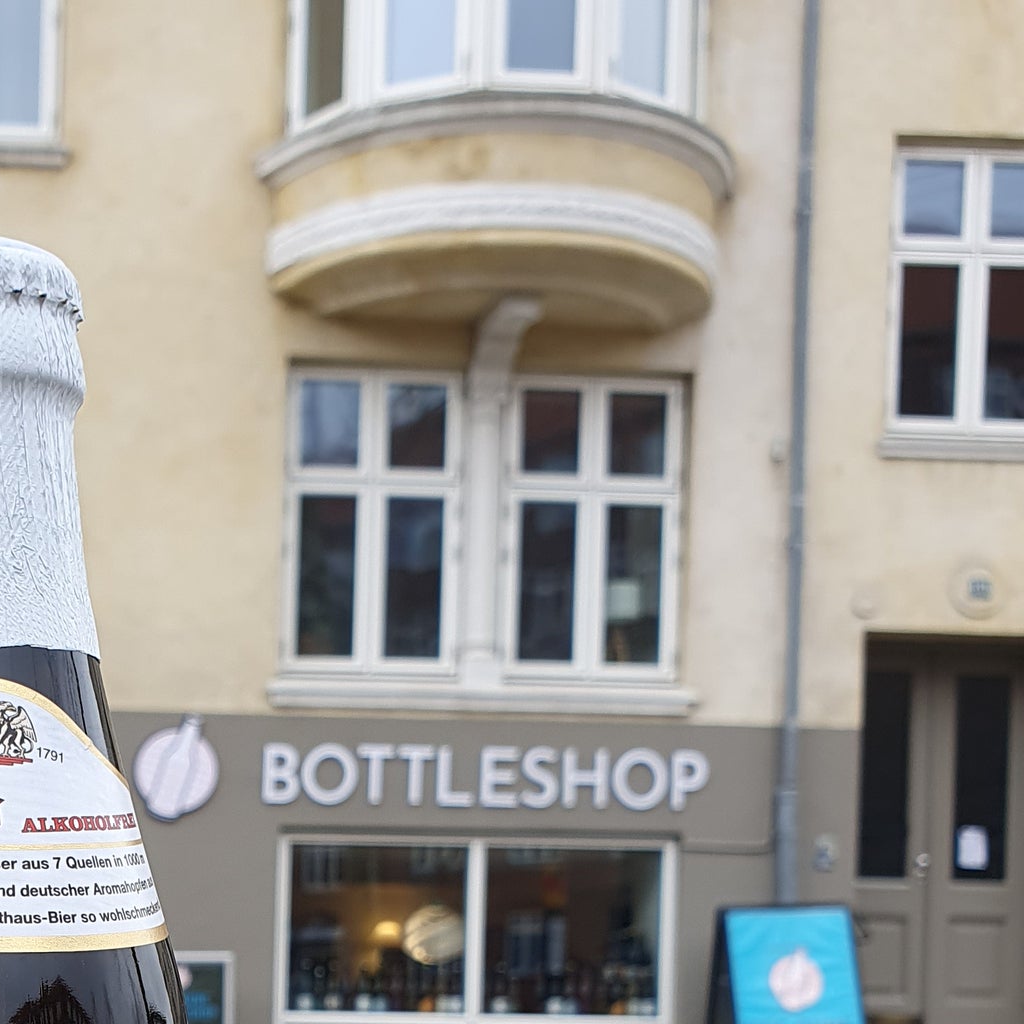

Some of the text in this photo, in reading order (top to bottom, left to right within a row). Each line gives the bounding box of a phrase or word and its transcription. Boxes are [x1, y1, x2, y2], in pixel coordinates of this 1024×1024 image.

[36, 747, 64, 763] 1791
[261, 743, 711, 811] BOTTLESHOP
[22, 859, 50, 870] aus
[52, 856, 61, 870] 7
[66, 856, 113, 870] Quellen
[113, 854, 123, 867] in
[20, 883, 90, 897] deutscher
[93, 877, 147, 896] Aromahopfen
[81, 911, 97, 923] so
